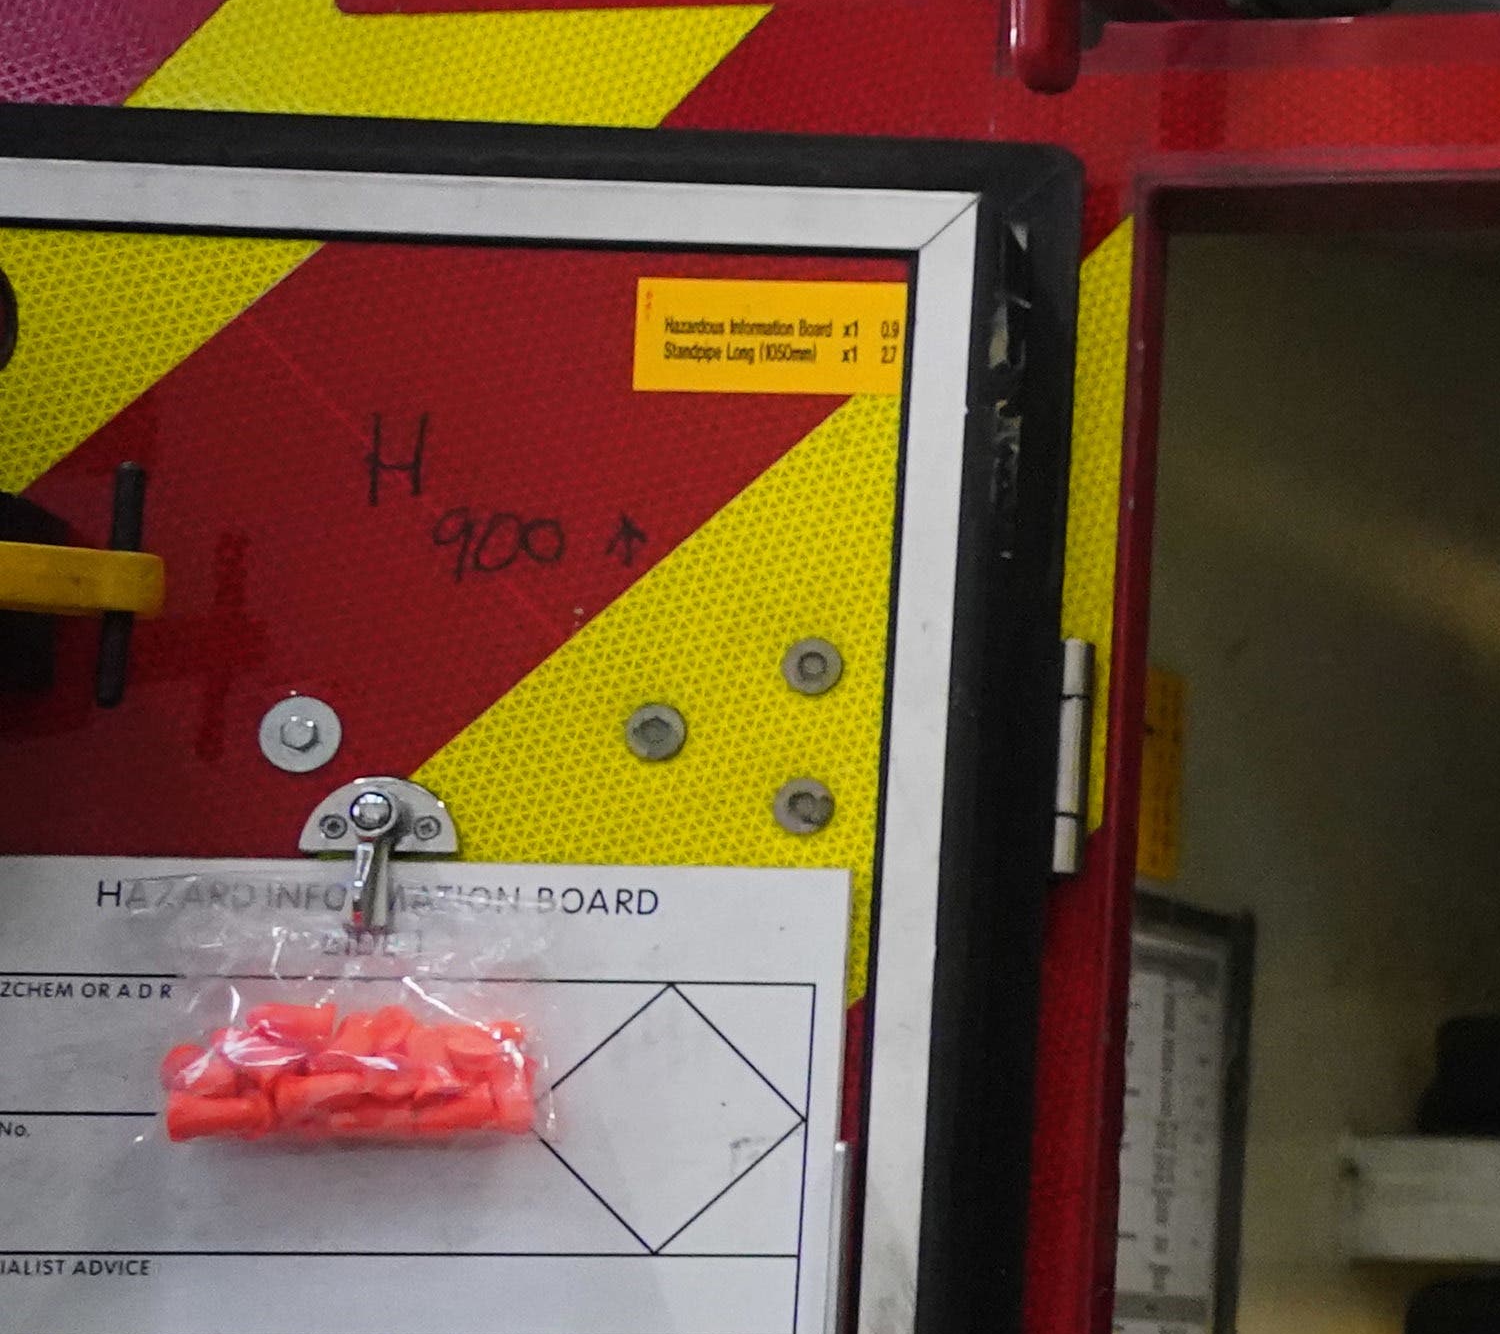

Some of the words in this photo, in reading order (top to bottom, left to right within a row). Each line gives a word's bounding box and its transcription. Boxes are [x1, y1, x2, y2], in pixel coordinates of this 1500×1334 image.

[664, 316, 725, 336] Hazardous
[730, 318, 794, 337] Information
[798, 319, 833, 338] Board
[842, 321, 860, 339] x1
[880, 320, 899, 340] 0.9
[663, 341, 722, 364] Standpipe
[726, 343, 755, 365] Long
[759, 343, 817, 364] (1050mm)
[841, 346, 858, 364] x1
[365, 410, 429, 507] H
[432, 506, 566, 583] 900
[97, 879, 257, 910] HAZARD
[537, 887, 659, 916] BOARD
[0, 982, 73, 999] ZCHEM
[81, 982, 110, 999] OR
[116, 983, 131, 999] A
[138, 983, 153, 999] D
[160, 983, 173, 999] R
[72, 1259, 152, 1277] ADVICE
